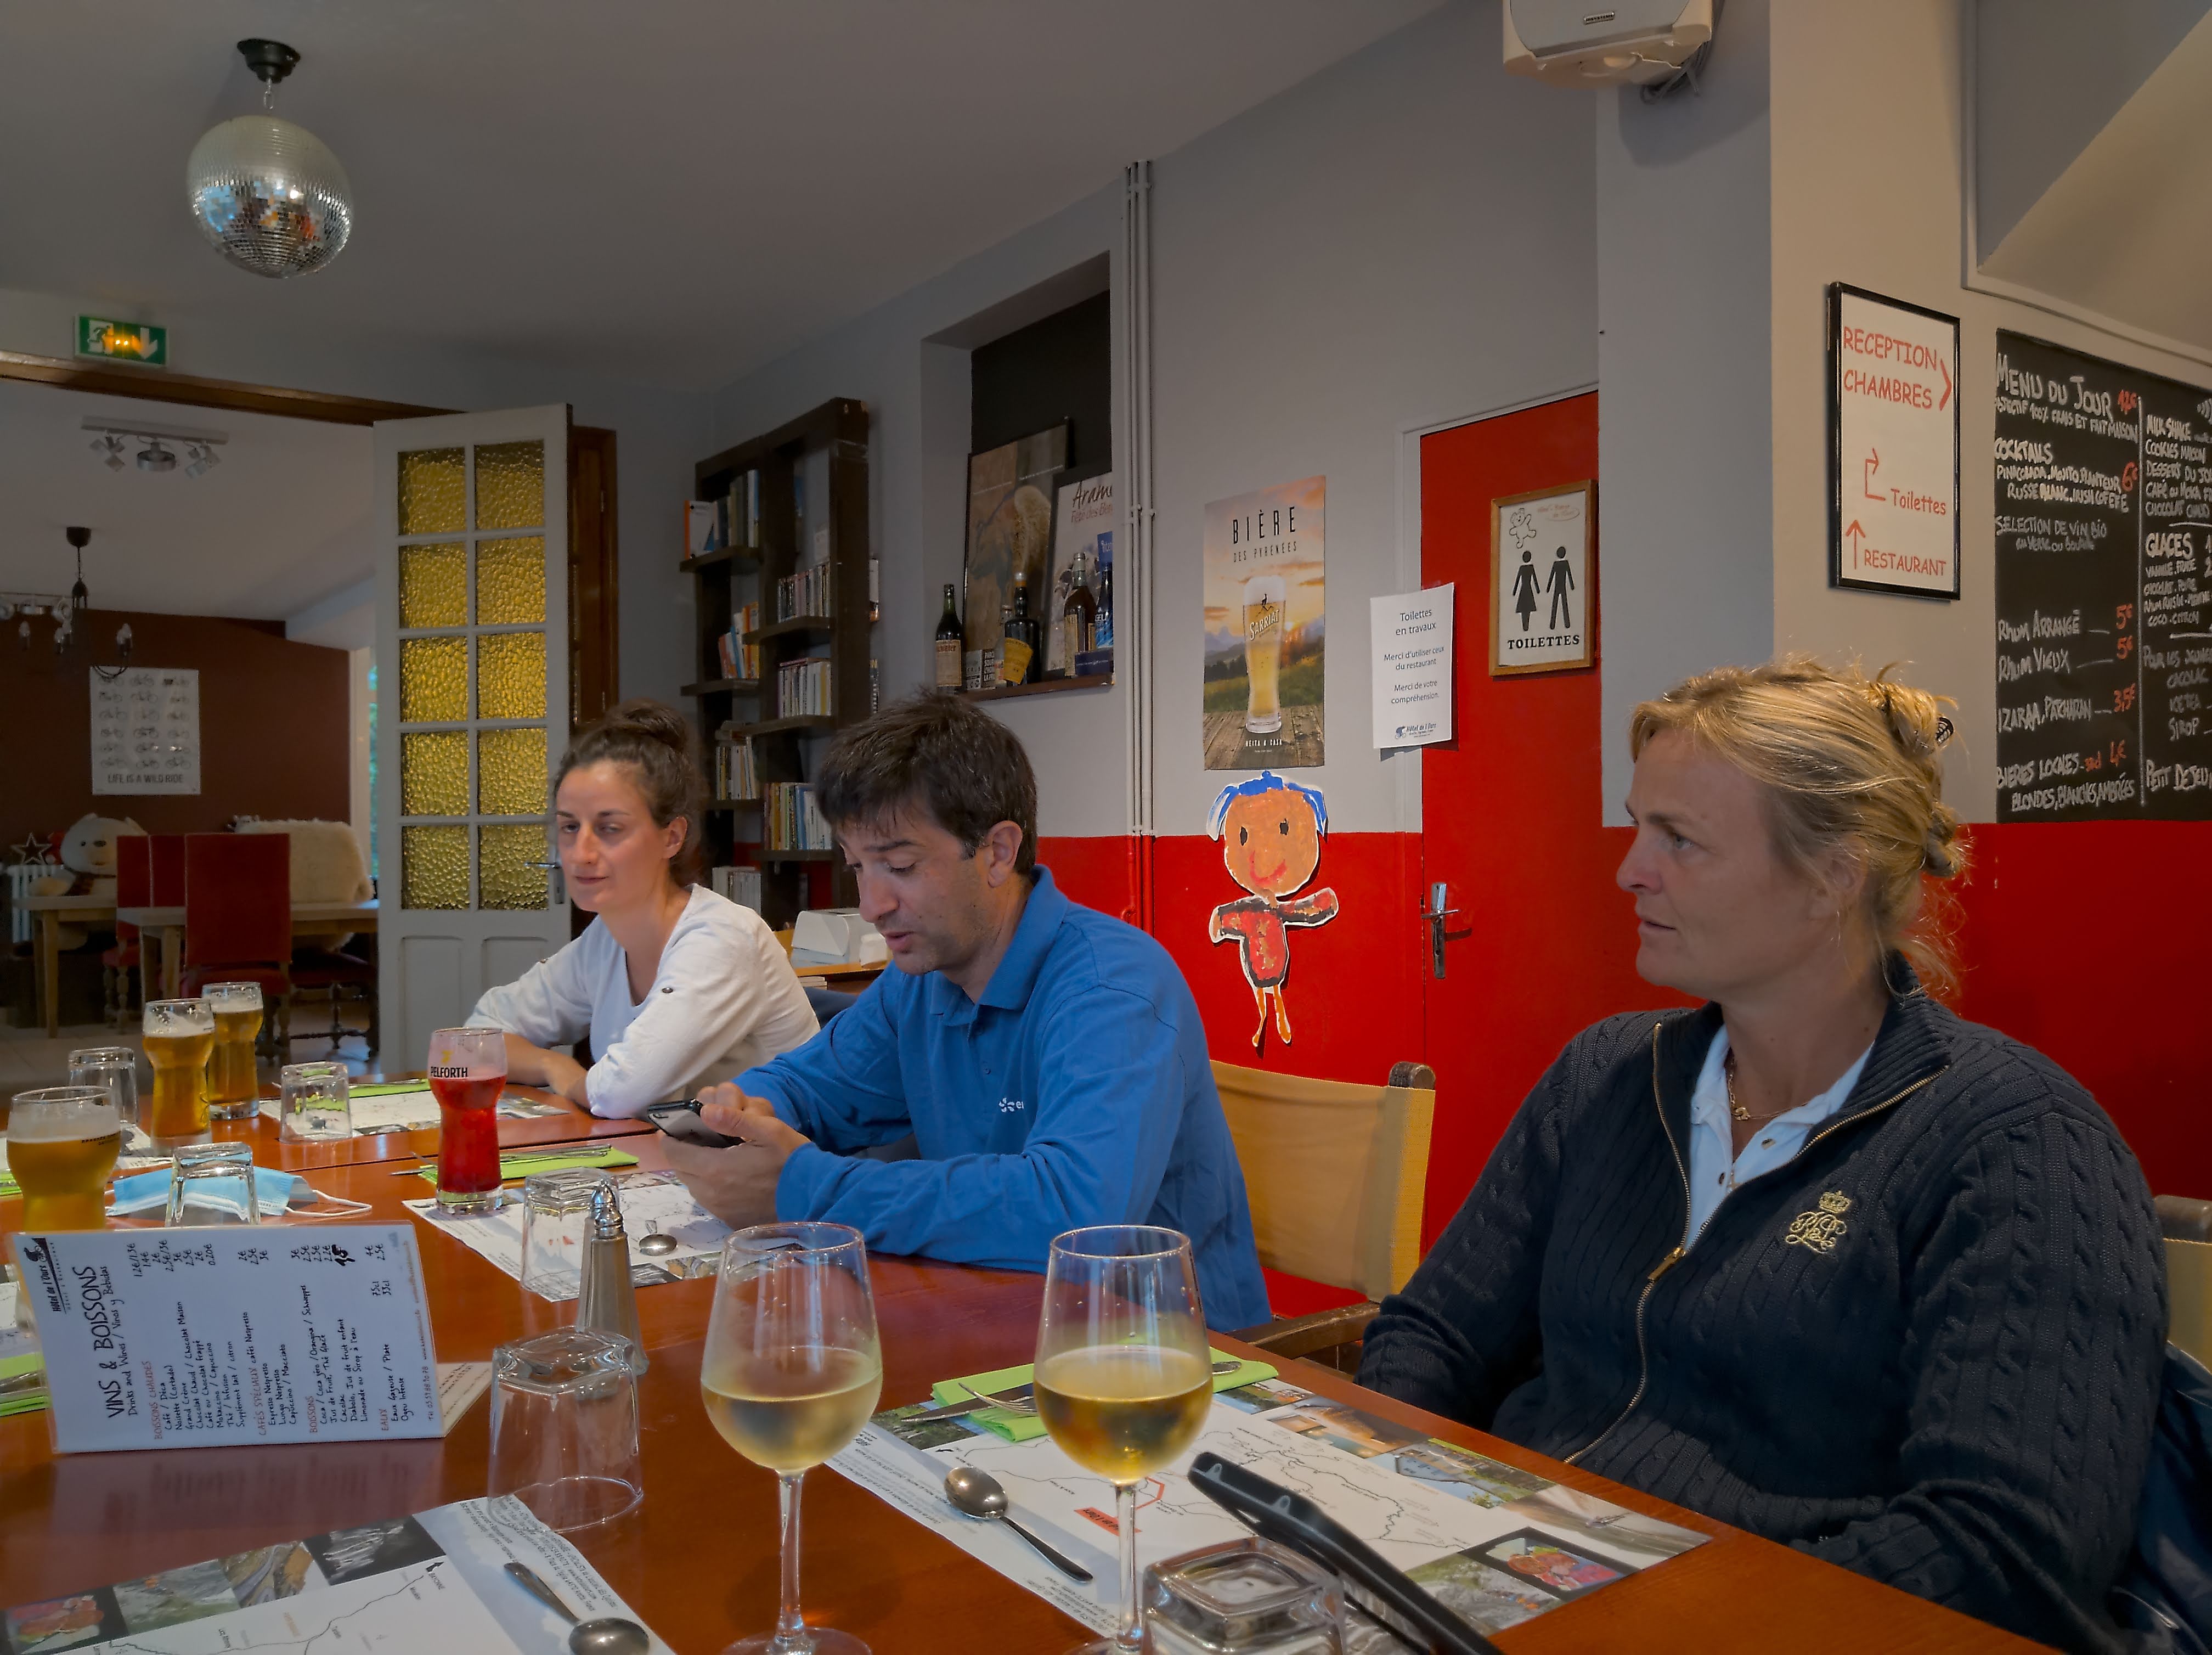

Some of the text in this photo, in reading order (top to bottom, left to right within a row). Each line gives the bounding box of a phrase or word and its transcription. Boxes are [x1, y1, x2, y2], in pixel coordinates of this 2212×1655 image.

[1843, 326, 1937, 371] RECEPTION
[1844, 369, 1932, 409] CHAMBRES
[1996, 352, 2114, 423] MENU DU JOUR
[1994, 437, 2053, 465] COCKTAILS
[1891, 488, 1946, 515] Toilettes
[1233, 506, 1295, 544] BIÈRE
[1995, 515, 2050, 536] SELECTION
[2055, 520, 2068, 536] DE
[1234, 550, 1246, 562] DES
[2145, 532, 2193, 560] GLACES
[1865, 549, 1946, 576] RESTAURANT
[1250, 609, 1280, 641] SARRIAT
[1400, 609, 1432, 621] Toilettes
[1409, 622, 1436, 634] travaux
[1384, 646, 1444, 661] Merci d'utiliser ceux
[1507, 635, 1579, 650] TOILETTES
[1407, 658, 1436, 669] restaurant
[1394, 683, 1413, 691] Merci
[108, 774, 125, 784] LIFE
[127, 774, 134, 783] IS
[144, 774, 163, 783] WILD
[165, 774, 184, 783] RIDE
[431, 1066, 468, 1078] PELFORTH
[100, 1266, 113, 1295] Bebidas
[371, 1281, 381, 1296] 75cl
[301, 1285, 311, 1315] Schweppes
[111, 1310, 121, 1328] Vinos
[177, 1302, 185, 1325] Maison
[72, 1266, 125, 1418] VINS & BOISSONS
[337, 1319, 346, 1340] enfant
[118, 1343, 128, 1366] Wines
[182, 1328, 192, 1359] Chocolat
[207, 1343, 218, 1378] Capuccino
[279, 1344, 289, 1377] Macciato
[353, 1355, 362, 1372] Sirop
[122, 1371, 132, 1386] and
[164, 1365, 177, 1399] (Cortado)
[199, 1366, 208, 1395] Chocolat
[222, 1374, 230, 1400] Infusion
[243, 1312, 266, 1436] CAFÉS SPÉCIAUX cafés Nespresso
[262, 1363, 272, 1394] Nespresso
[142, 1361, 162, 1440] BOISSONS CHAUDES
[180, 1382, 189, 1405] Crème
[274, 1369, 289, 1425] Lungo Nespresso
[388, 1375, 400, 1400] Gazeuse
[127, 1391, 137, 1416] Drinks
[194, 1398, 203, 1429] Chocolat
[207, 1399, 211, 1408] ou
[235, 1389, 246, 1427] Supplément
[268, 1397, 277, 1425] Expresso
[288, 1388, 298, 1425] Capuccino
[306, 1395, 318, 1433] BOISSONS
[391, 1405, 399, 1422] Eaux
[401, 1404, 414, 1421] Ogeu
[162, 1414, 171, 1429] Café
[205, 1412, 213, 1428] Café
[377, 1409, 389, 1431] EAUX
